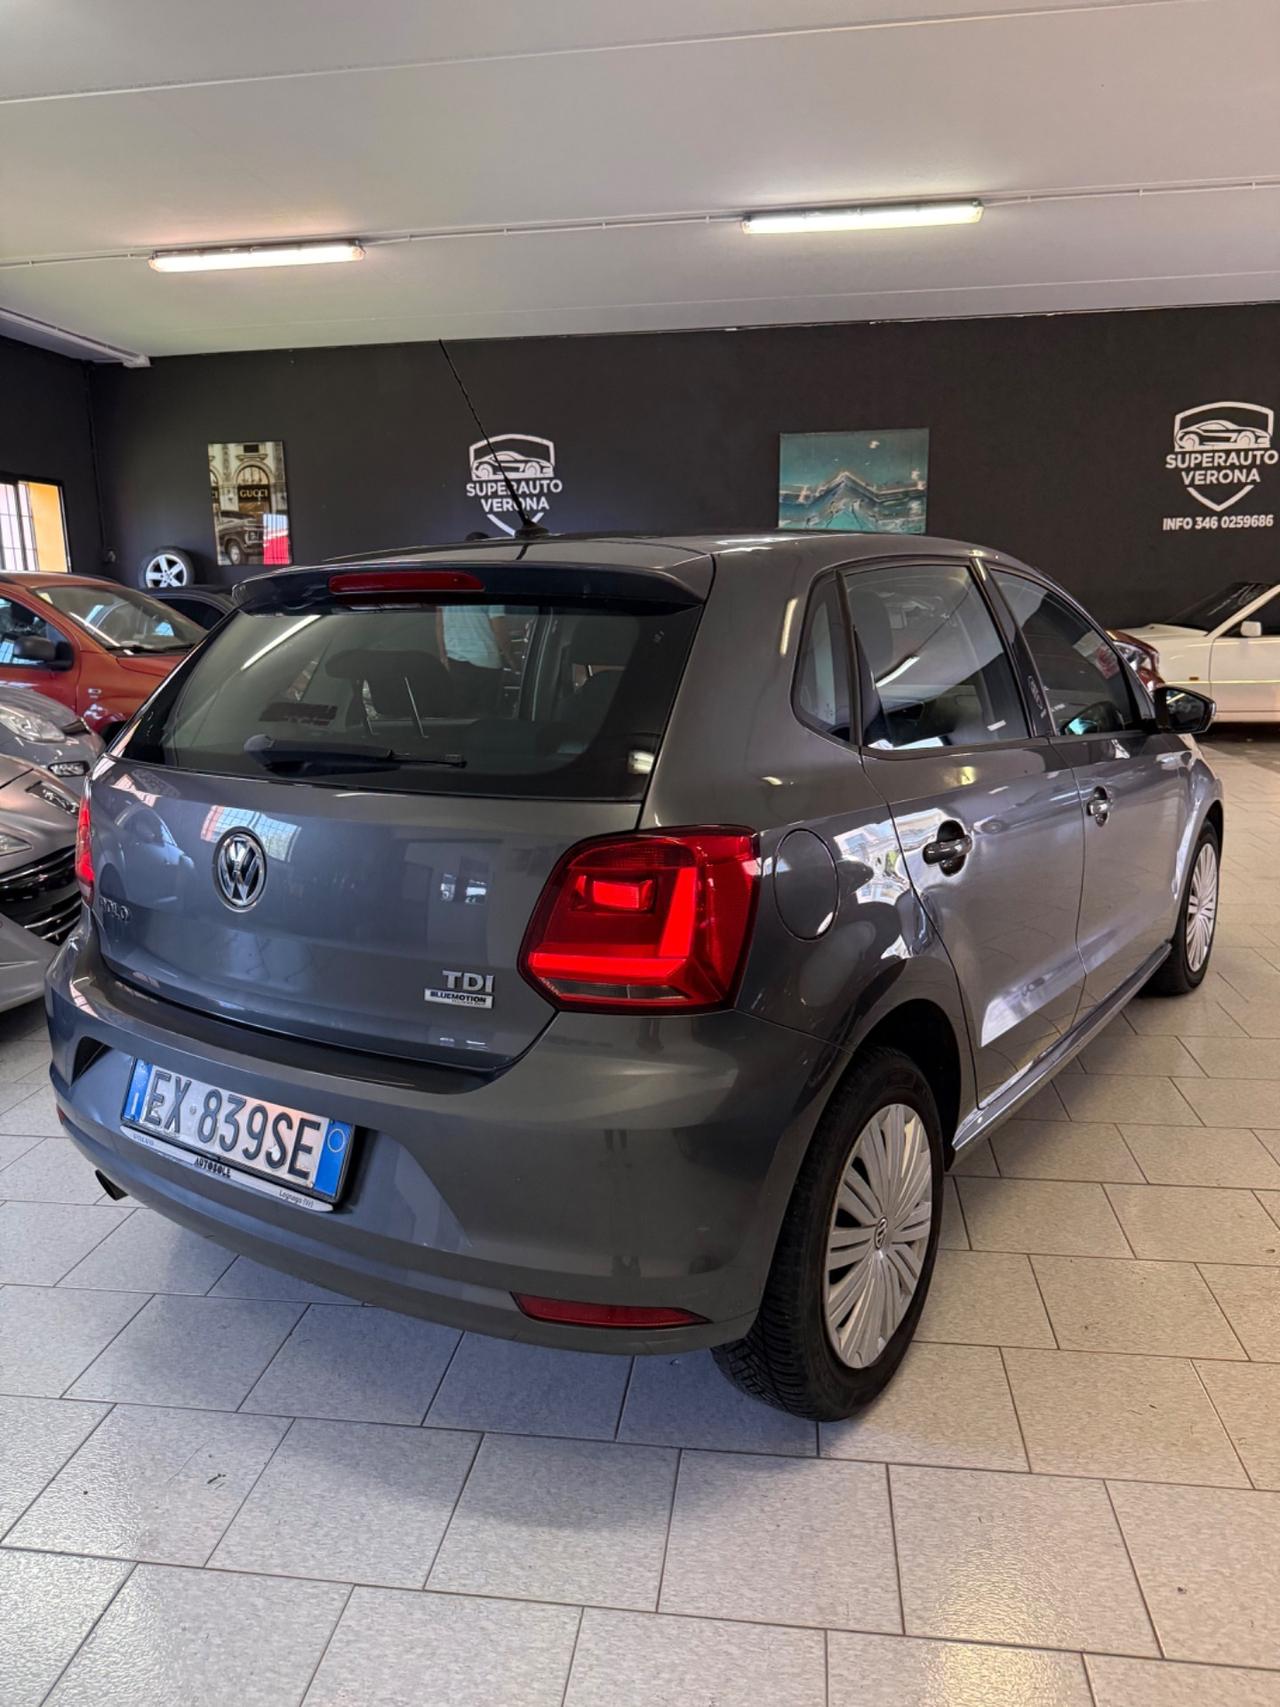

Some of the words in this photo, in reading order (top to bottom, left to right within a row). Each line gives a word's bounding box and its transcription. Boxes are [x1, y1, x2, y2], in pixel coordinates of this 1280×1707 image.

[1165, 450, 1279, 469] SUPERAUTO
[1181, 468, 1261, 485] VERONA
[240, 488, 269, 498] GUCCI
[481, 497, 550, 512] VERONA
[1163, 517, 1193, 531] INFO
[1195, 516, 1219, 530] 346
[1220, 514, 1275, 529] 0259686
[442, 970, 494, 993] TDI
[430, 991, 487, 1003] BLUEMOTION
[144, 1069, 192, 1134] EX
[197, 1088, 321, 1180] 839SE
